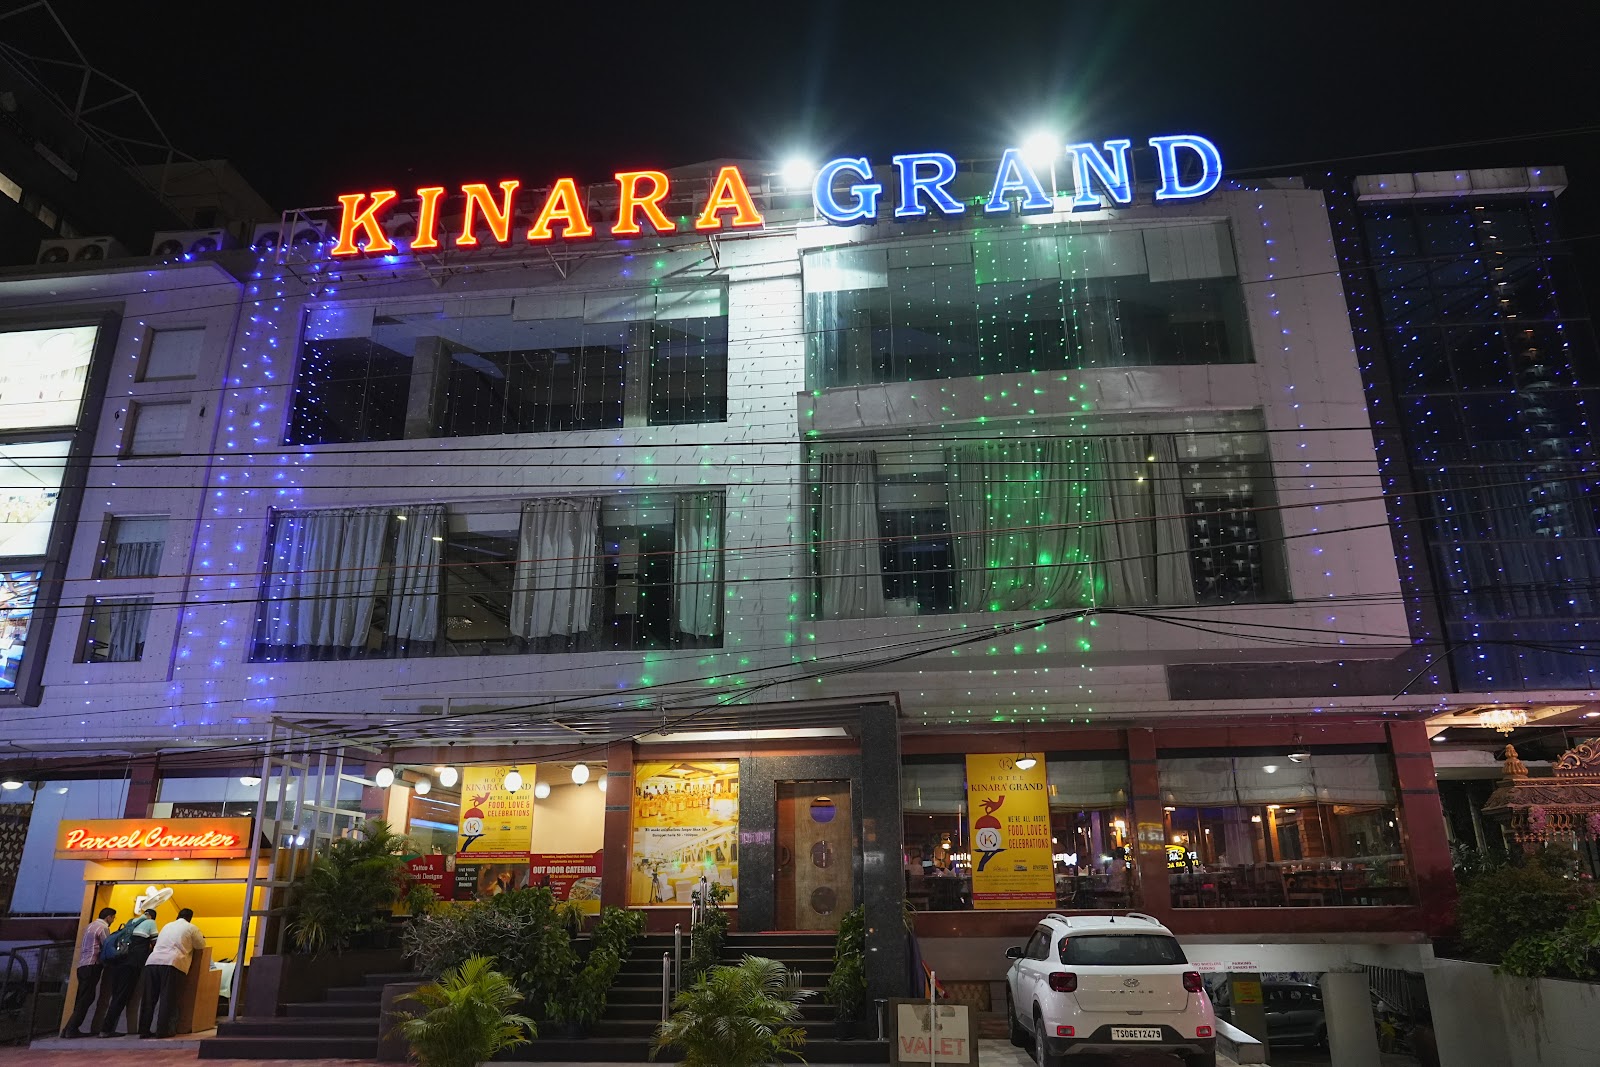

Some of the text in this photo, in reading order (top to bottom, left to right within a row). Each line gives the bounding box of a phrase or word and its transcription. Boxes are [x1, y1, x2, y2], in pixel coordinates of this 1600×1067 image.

[331, 134, 1224, 257] KINARA GRAND
[466, 783, 498, 791] KINARA
[971, 782, 1044, 792] KINARA GRAND
[488, 801, 506, 809] FOOD,
[1008, 824, 1048, 836] FOOD, LOVE &
[66, 826, 237, 848] Parcel Counter
[1008, 838, 1049, 849] CELEBRATIONS
[533, 866, 546, 874] OUT
[1116, 1030, 1160, 1038] TS06EY2479
[900, 1036, 966, 1056] VALET
